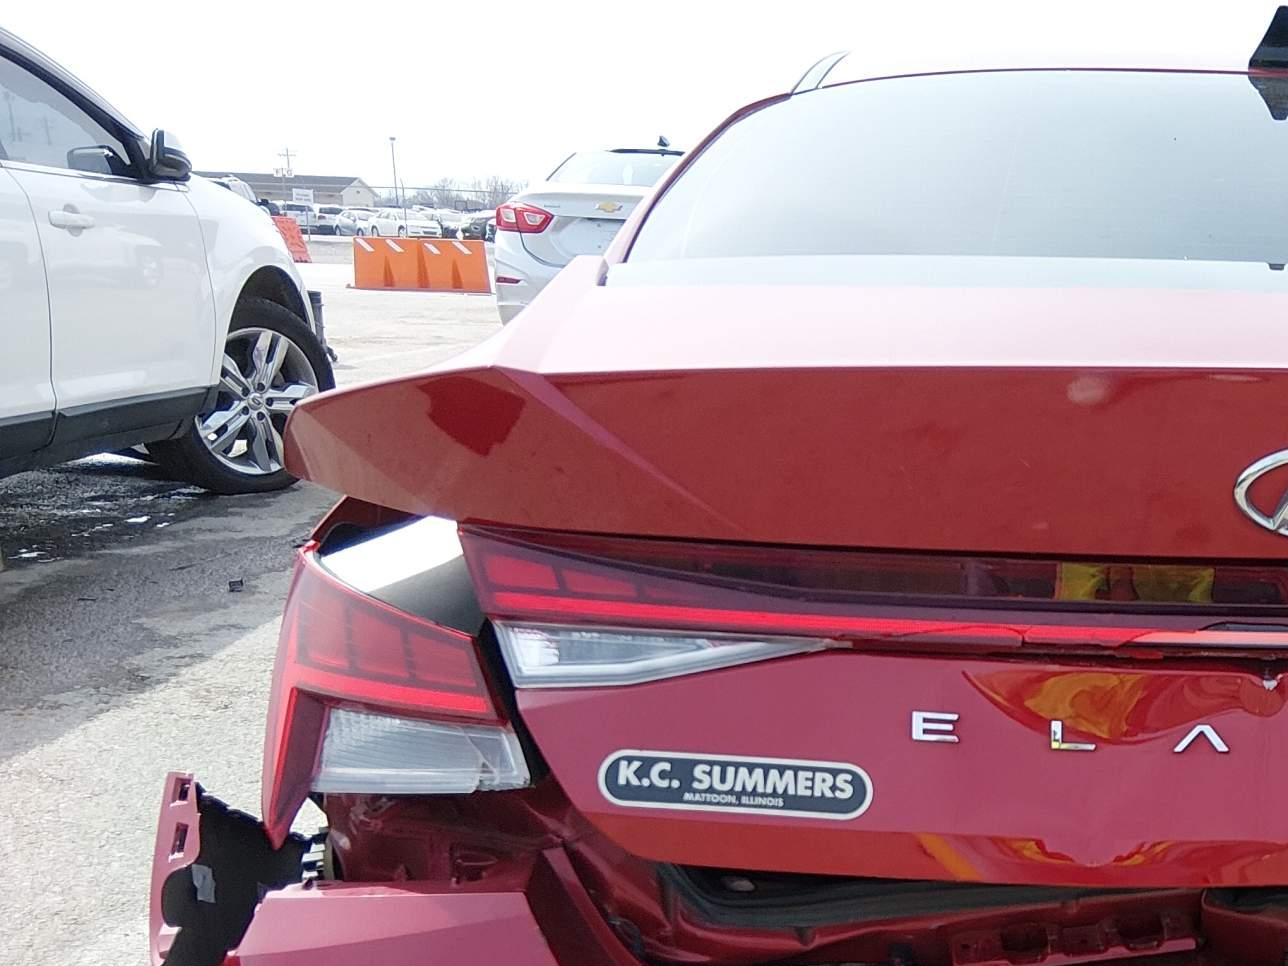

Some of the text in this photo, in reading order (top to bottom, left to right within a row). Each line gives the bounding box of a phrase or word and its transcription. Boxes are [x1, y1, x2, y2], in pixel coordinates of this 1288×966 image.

[617, 760, 854, 799] K.C. SUMMERS
[683, 791, 784, 808] MATTOON, ILLINOIS
